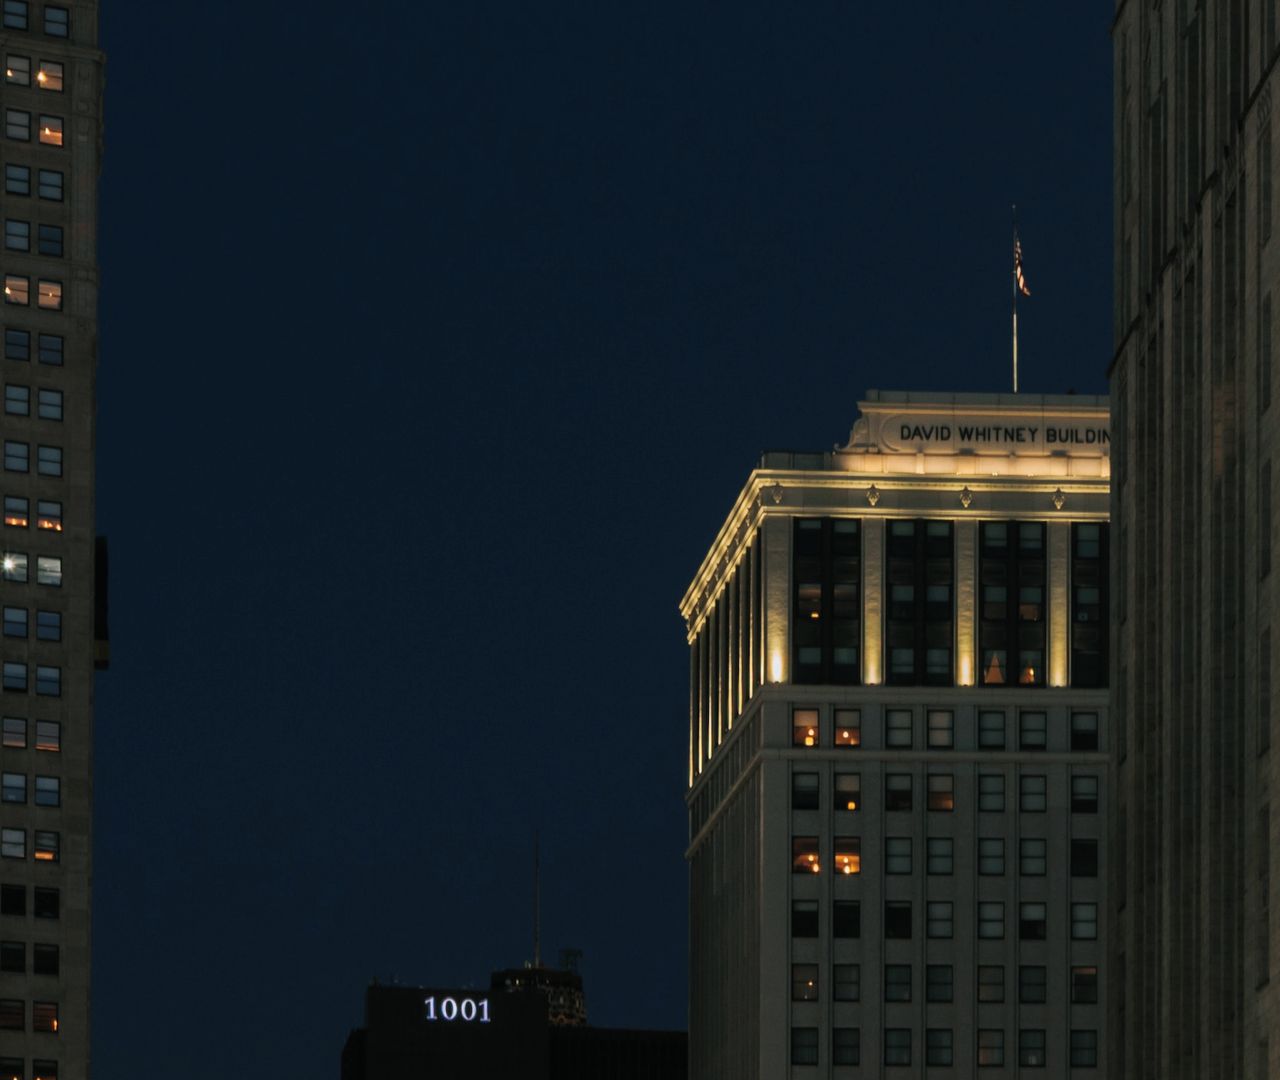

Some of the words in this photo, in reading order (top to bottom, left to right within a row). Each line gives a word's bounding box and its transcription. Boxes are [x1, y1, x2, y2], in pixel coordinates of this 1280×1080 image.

[901, 425, 951, 441] DAVID
[959, 426, 1038, 443] WHITNEY
[1046, 428, 1111, 444] BUILDIN
[424, 996, 491, 1022] 1001
